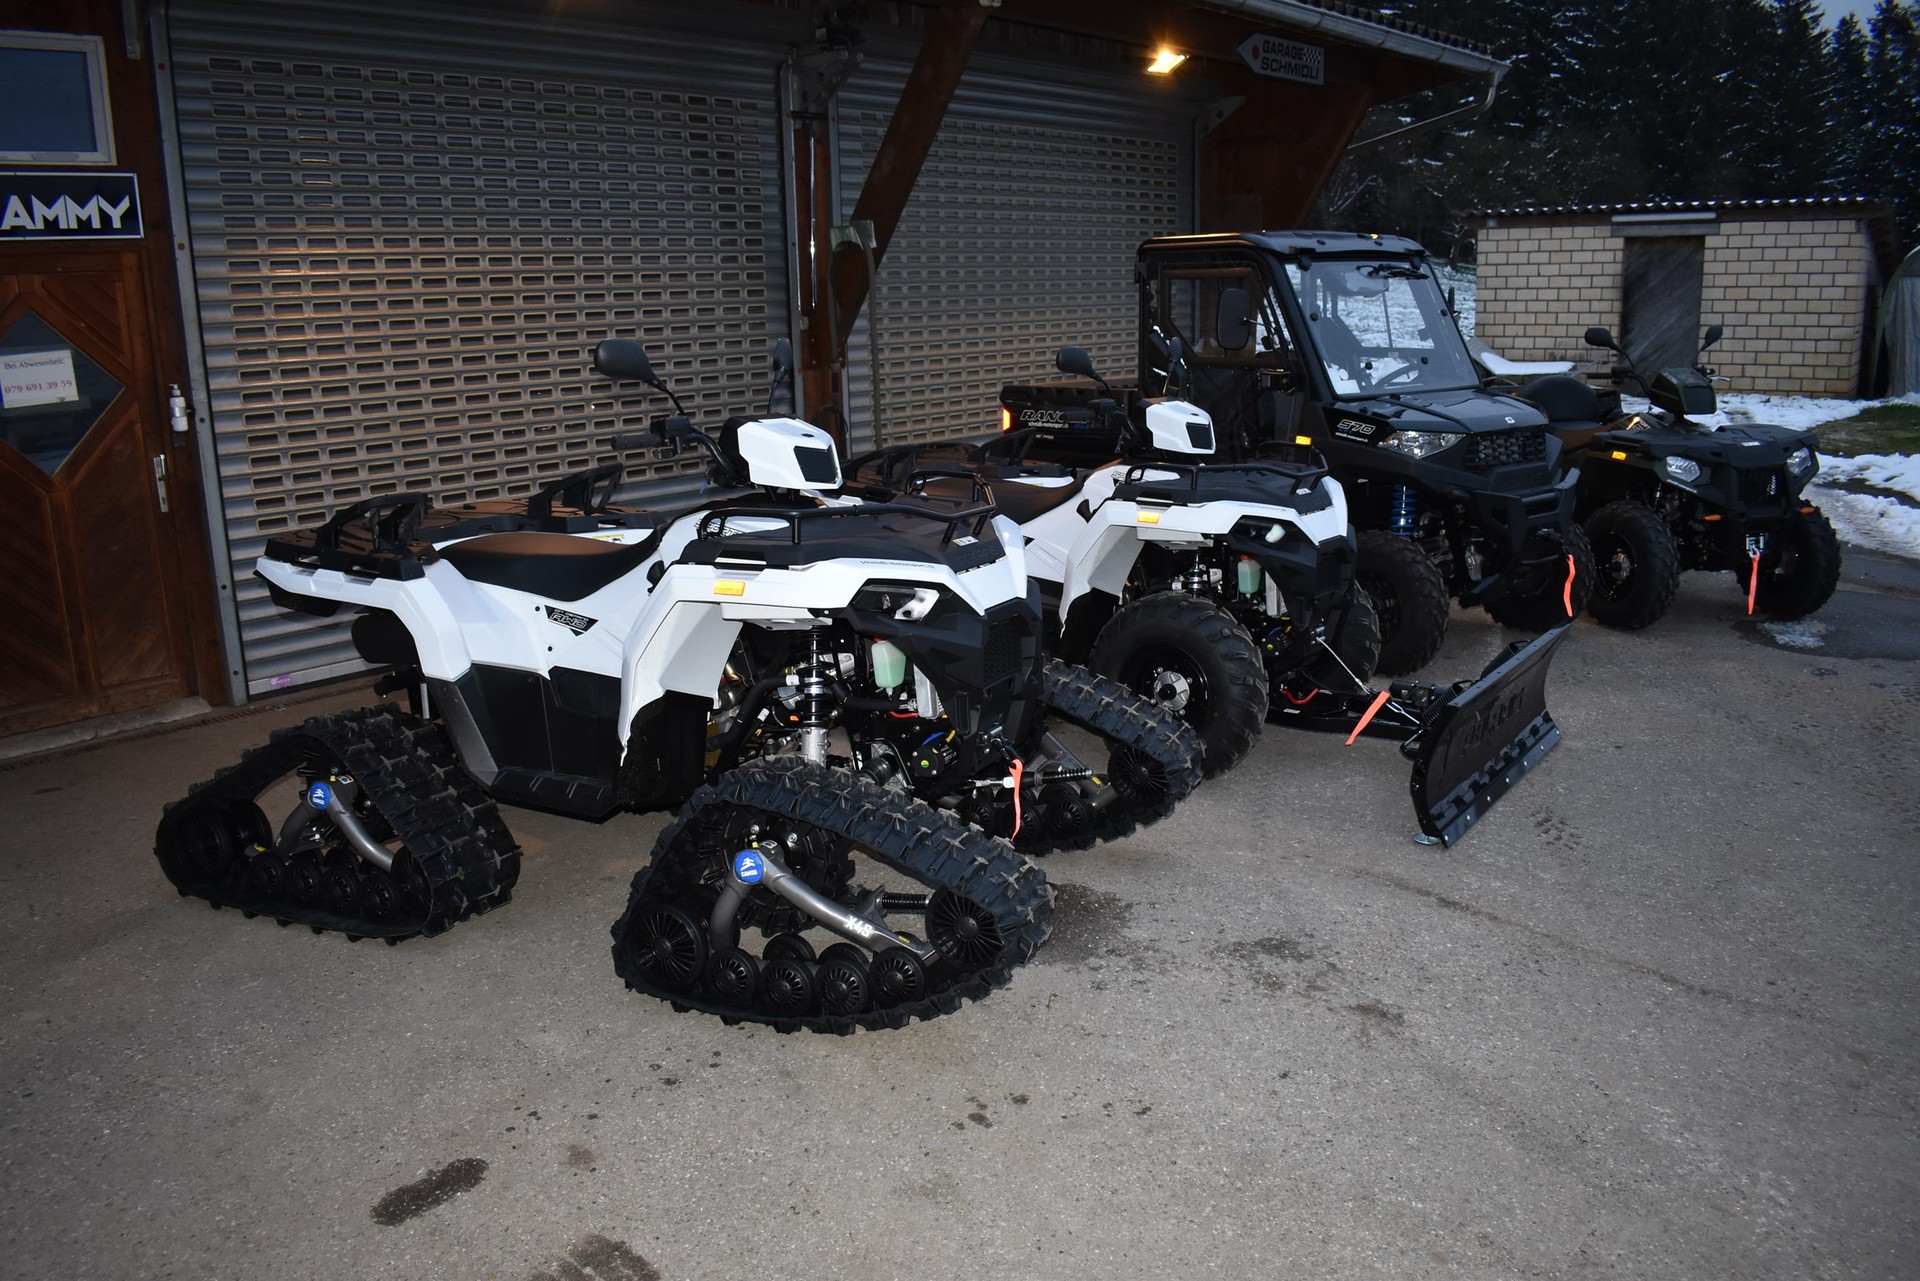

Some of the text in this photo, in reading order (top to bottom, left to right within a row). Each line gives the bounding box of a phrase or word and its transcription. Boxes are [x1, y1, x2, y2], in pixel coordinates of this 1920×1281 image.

[1262, 40, 1304, 61] GARAGE
[1261, 56, 1320, 80] SCHMIDLI
[5, 362, 18, 370] Bei
[5, 379, 73, 394] 079 691 39 59
[1337, 418, 1375, 434] 570
[549, 612, 587, 629] AWD
